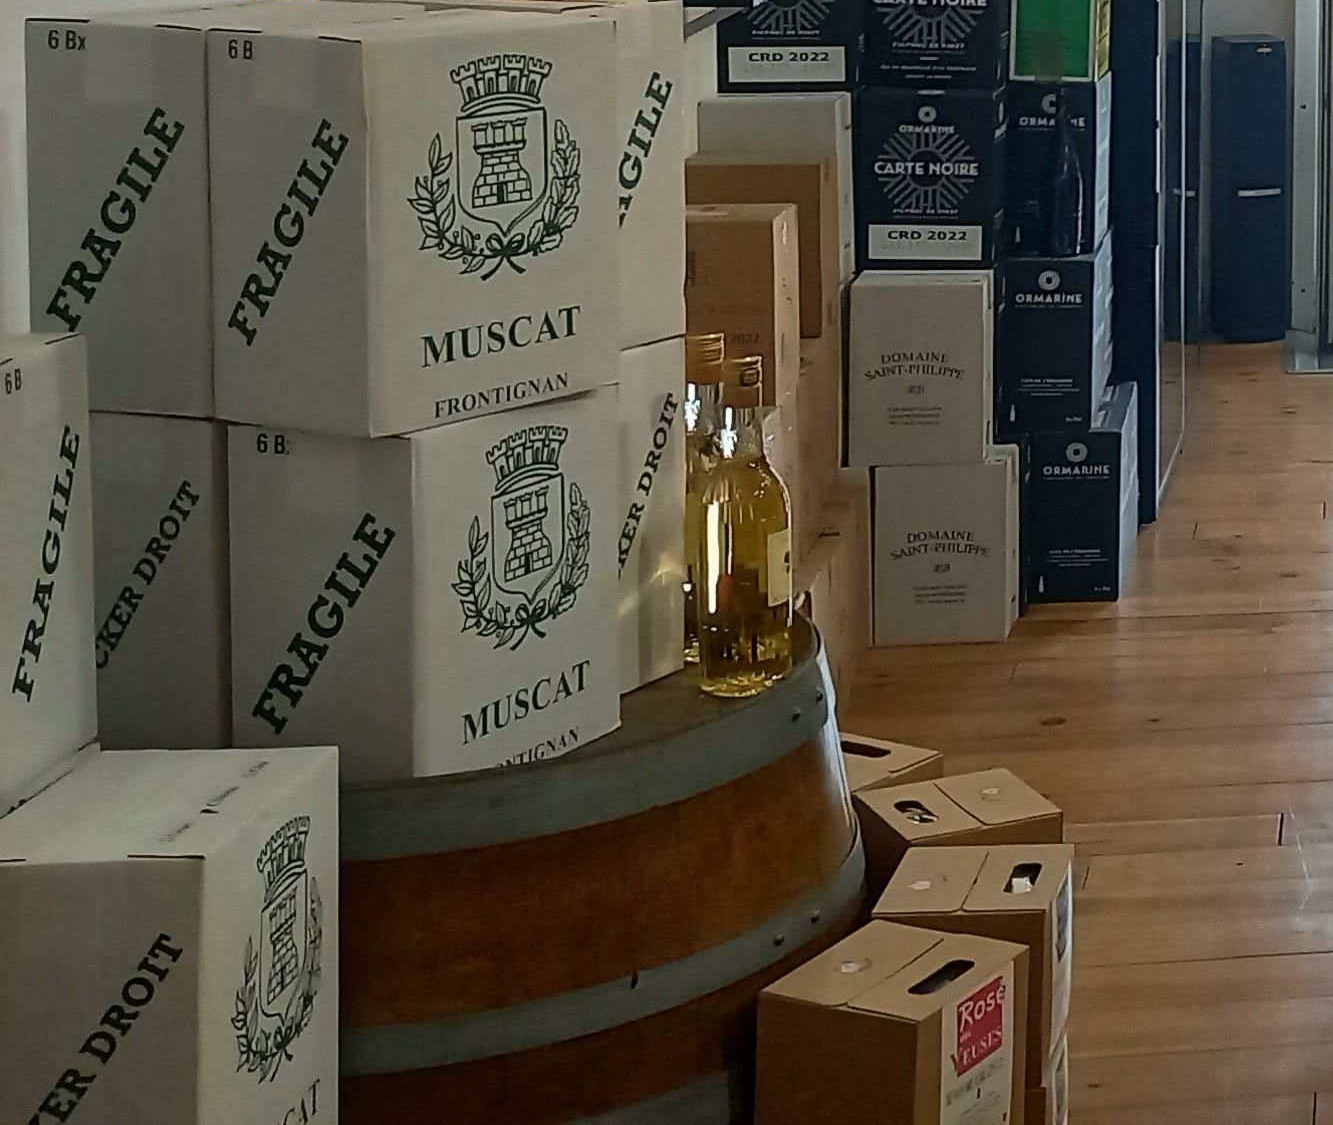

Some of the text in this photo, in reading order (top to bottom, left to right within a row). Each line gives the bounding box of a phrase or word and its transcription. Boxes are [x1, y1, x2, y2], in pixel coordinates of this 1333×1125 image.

[47, 30, 87, 52] 6 Bx
[228, 40, 239, 60] 6
[748, 51, 830, 63] CRD 2022
[618, 71, 674, 228] GILE
[873, 161, 979, 176] CARTE NOIRE
[46, 107, 186, 332] FRAGILE
[227, 118, 349, 346] FRAGILE
[887, 231, 968, 241] CRD 2022
[1015, 292, 1083, 304] ORMARINE
[420, 304, 582, 368] MUSCAT
[880, 352, 949, 365] DOMAINE
[863, 364, 966, 381] SAINT-PHILIPPE
[433, 371, 570, 420] FRONTIGNAN
[257, 433, 268, 455] 6
[637, 393, 680, 498] DROIT
[1042, 465, 1111, 476] ORMARINE
[132, 480, 201, 586] DROIT
[906, 531, 975, 544] DOMAINE
[890, 543, 990, 561] SAINT-PHILIPPE
[11, 424, 81, 703] FRAGILE
[251, 512, 397, 736] FRAGILE
[460, 659, 593, 746] MUSCAT
[78, 931, 184, 1066] DROIT
